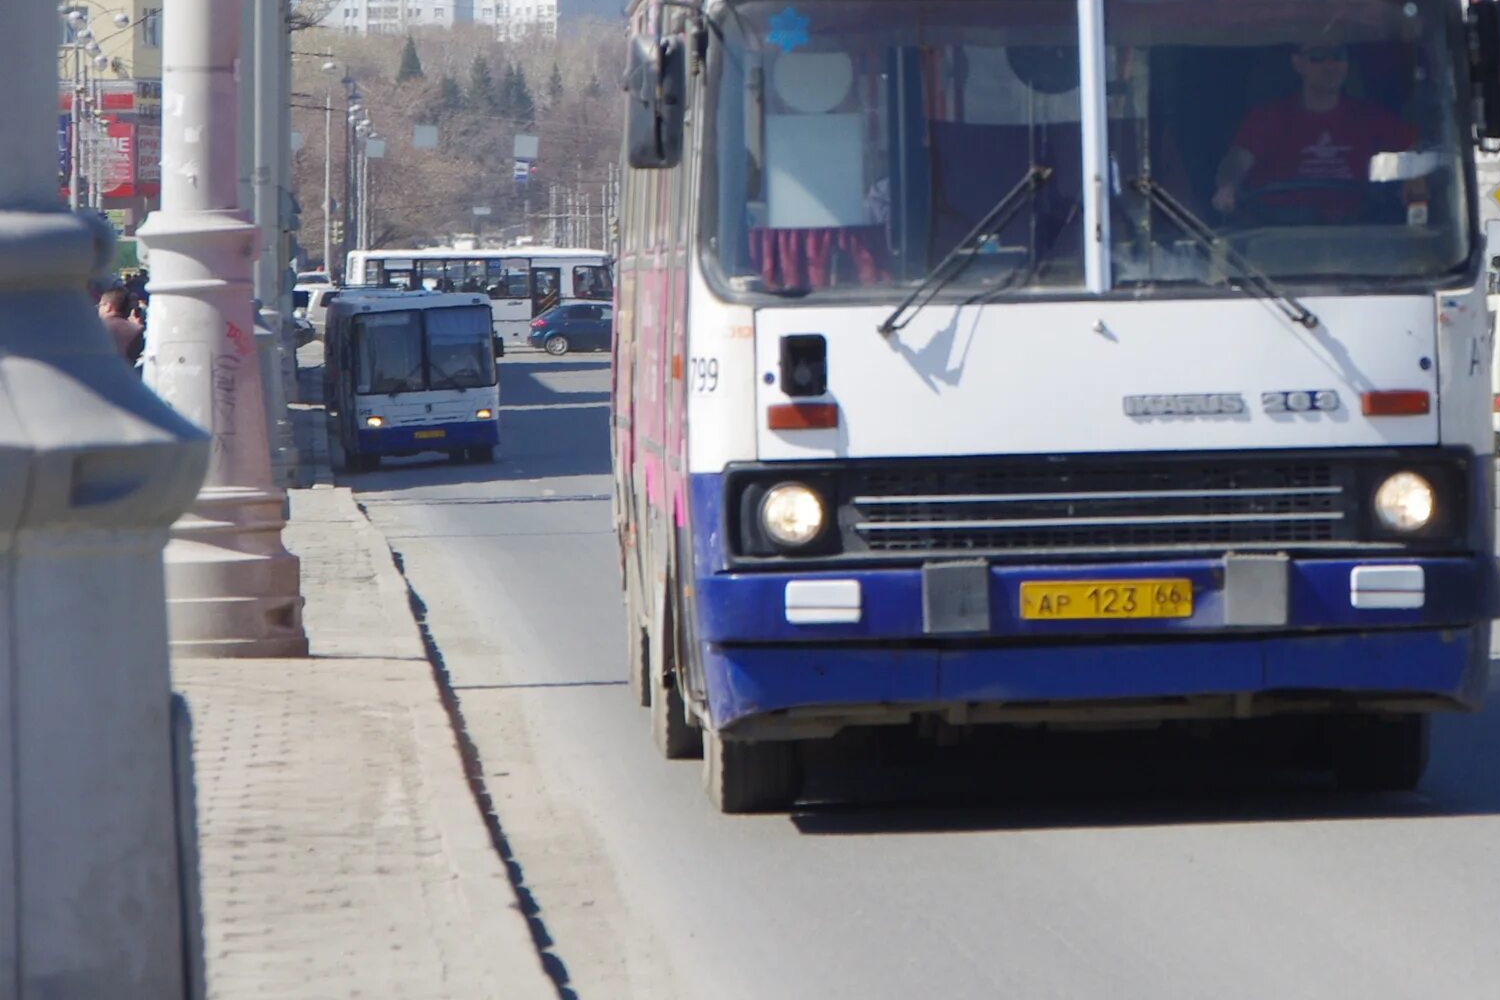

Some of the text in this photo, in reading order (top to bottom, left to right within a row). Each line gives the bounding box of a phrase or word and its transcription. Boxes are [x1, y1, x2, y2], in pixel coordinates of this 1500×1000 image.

[1122, 393, 1246, 417] IKARUS
[1087, 587, 1137, 614] 123
[1155, 585, 1182, 605] 66
